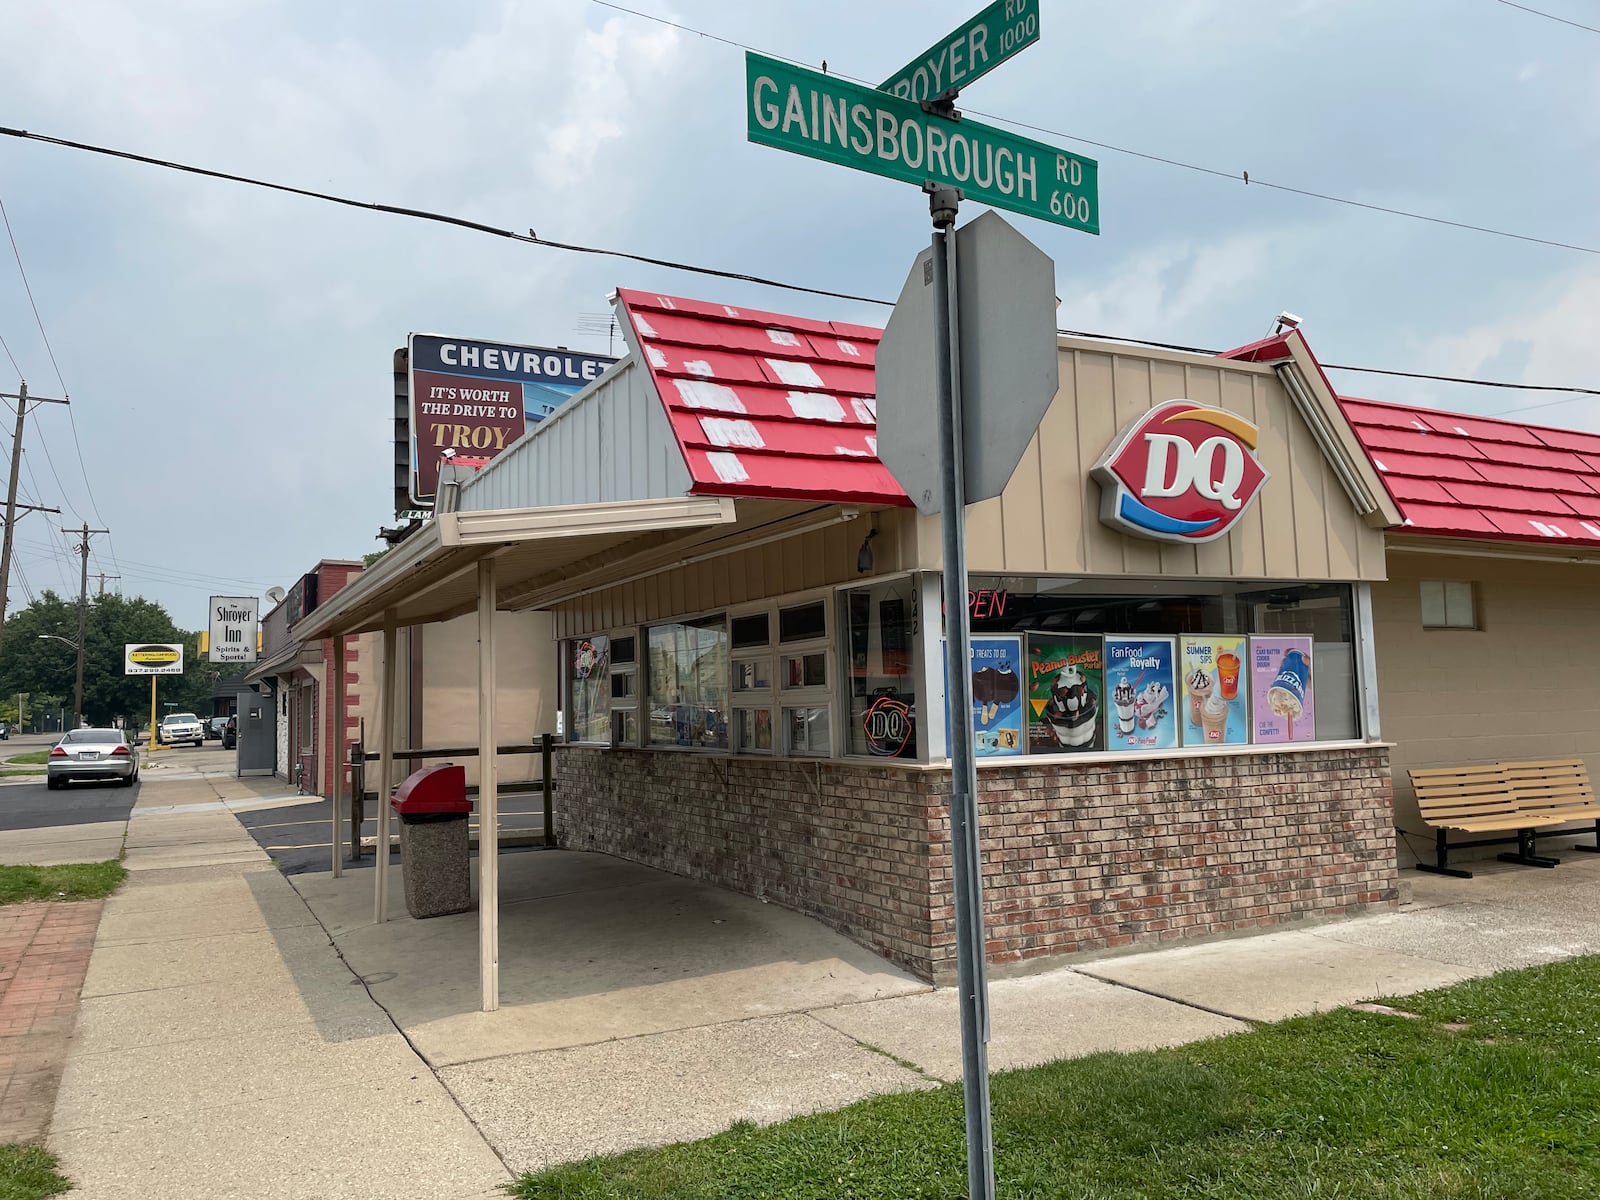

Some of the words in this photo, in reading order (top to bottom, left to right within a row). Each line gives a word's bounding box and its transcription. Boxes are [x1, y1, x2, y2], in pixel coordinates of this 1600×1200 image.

[1000, 13, 1036, 54] 1000
[753, 76, 1037, 201] GAINSBOROUGH
[1056, 153, 1082, 186] RD
[1050, 190, 1090, 223] 600
[459, 388, 510, 402] WORTH
[422, 402, 450, 415] THE
[453, 404, 496, 417] DRIVE
[499, 406, 517, 419] TO
[1140, 433, 1245, 510] DQ
[911, 572, 919, 636] 1042
[217, 606, 252, 624] Shroyer
[225, 625, 242, 642] Inn
[1067, 650, 1100, 665] Buster
[1186, 646, 1212, 655] SUMMER
[1130, 657, 1161, 670] Royalty
[1200, 655, 1213, 664] SIPS
[871, 710, 904, 743] DQ
